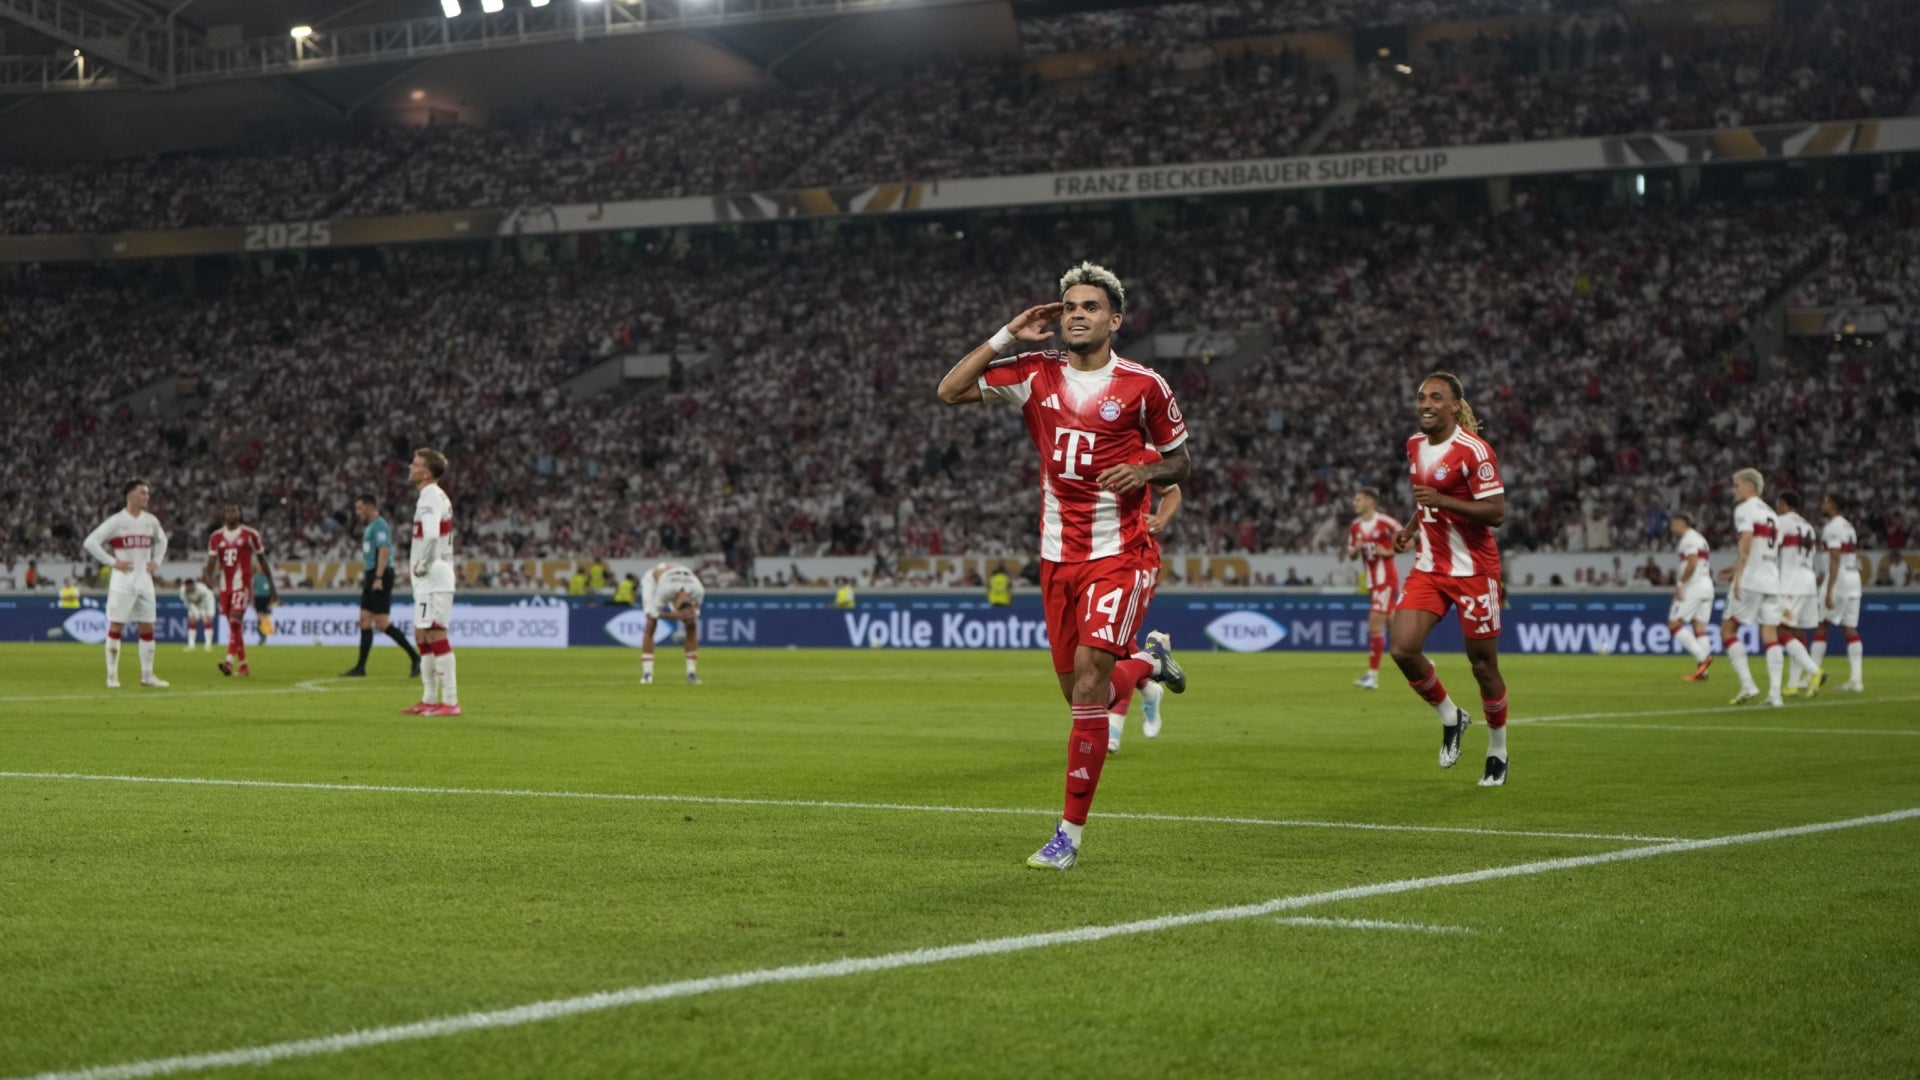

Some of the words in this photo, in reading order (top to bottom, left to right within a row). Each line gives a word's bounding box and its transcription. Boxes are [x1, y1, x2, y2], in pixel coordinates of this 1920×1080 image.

[1055, 172, 1131, 196] FRANZ
[1138, 161, 1309, 191] BECKENBAUER
[1317, 152, 1448, 181] SUPERCUP
[245, 221, 330, 250] 2025
[419, 602, 427, 619] 7
[1085, 583, 1123, 624] 14
[1460, 594, 1493, 622] 23
[448, 617, 511, 639] PERCUP
[516, 618, 559, 638] 2025
[619, 621, 644, 636] TEN
[844, 610, 932, 648] Volle
[1220, 625, 1268, 639] TENA
